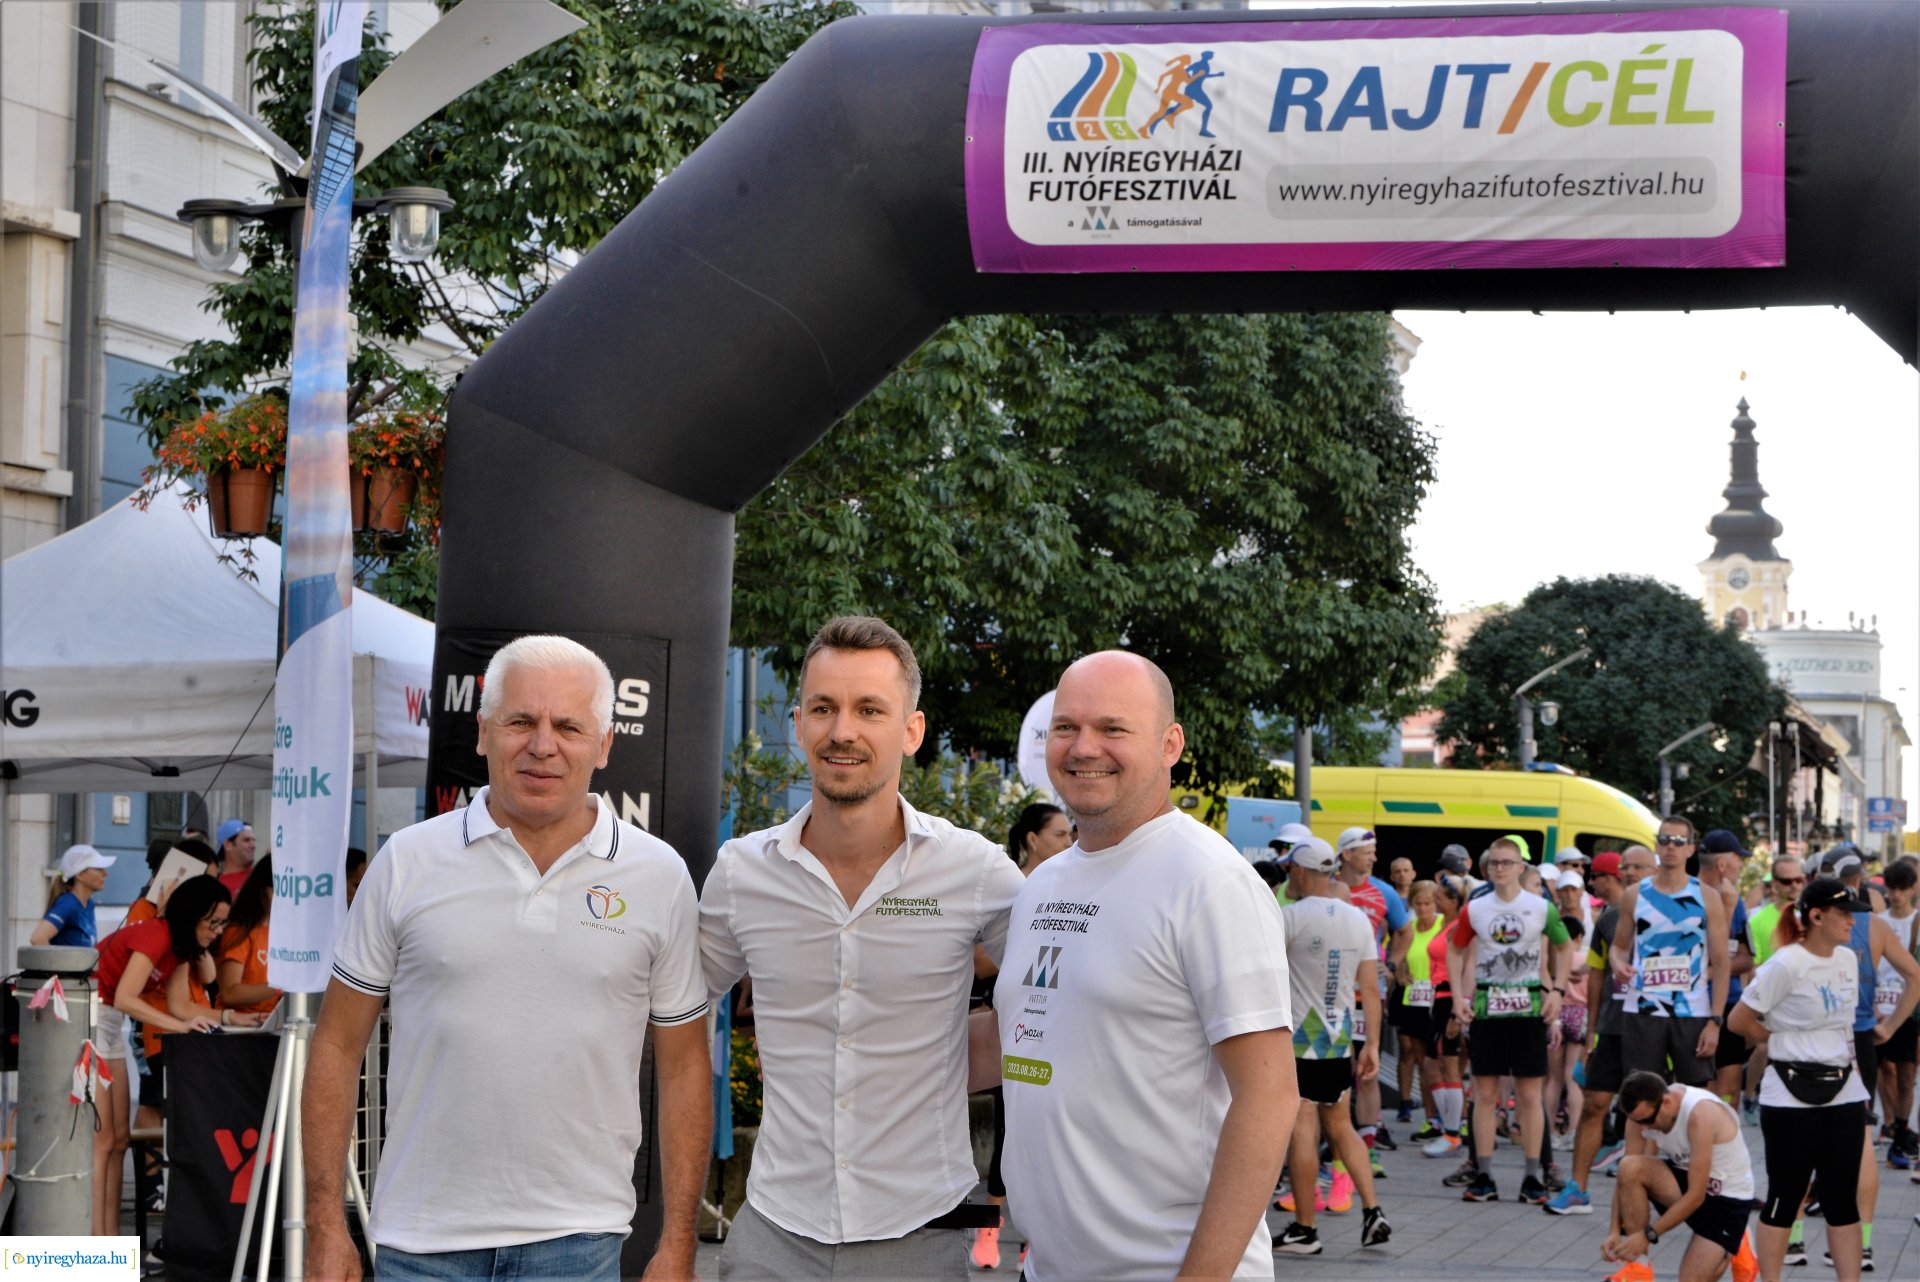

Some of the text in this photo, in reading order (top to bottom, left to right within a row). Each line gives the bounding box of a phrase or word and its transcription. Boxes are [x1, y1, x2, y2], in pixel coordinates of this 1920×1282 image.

[1268, 44, 1715, 134] RAJT/CÉL
[1023, 144, 1242, 174] III. NYÍREGYHÁZI
[1028, 174, 1238, 202] FUTÓFESZTIVÁL
[1278, 171, 1705, 206] www.nyiregyhazifutofesztival.hu
[1067, 216, 1202, 229] a támogatásával
[882, 896, 938, 907] NYÍREGYHÁZI
[1044, 899, 1101, 917] NYÍREGYHÁZI
[875, 906, 944, 917] FUTÓFESZTIVÁL
[580, 920, 626, 936] NYÍREGYHÁZA
[1029, 915, 1089, 934] FUTÓFESZTIVÁL
[1325, 950, 1340, 1019] FINISHER
[1643, 969, 1689, 985] 21126
